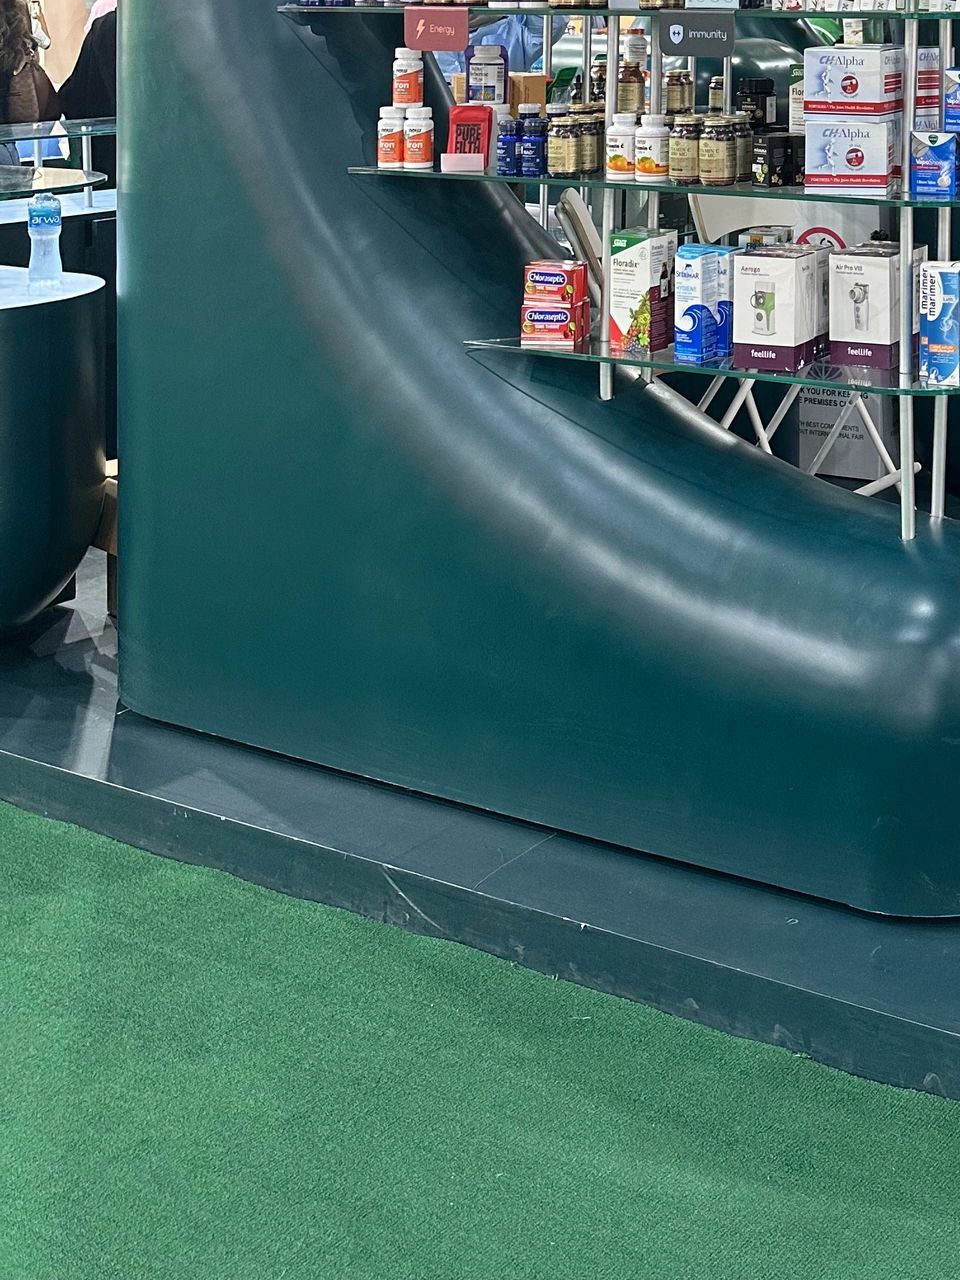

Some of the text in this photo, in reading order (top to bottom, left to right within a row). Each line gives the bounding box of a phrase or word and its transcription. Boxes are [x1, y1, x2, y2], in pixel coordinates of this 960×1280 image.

[429, 23, 456, 37] Energy
[688, 29, 728, 42] Immunity
[792, 87, 804, 96] Flor
[455, 126, 481, 141] PURE
[406, 141, 423, 149] Iron
[31, 215, 60, 224] arwa
[612, 258, 640, 269] Floradix
[529, 272, 565, 285] Chloraseptic
[920, 267, 929, 310] marimer
[929, 273, 937, 317] marimer
[527, 311, 567, 323] Chloraseptic
[750, 348, 777, 360] feellife
[847, 346, 873, 358] feellife
[822, 389, 838, 397] FOR
[837, 391, 869, 400] KEEG
[804, 397, 838, 408] PREMISES
[820, 422, 860, 432] COMENTS
